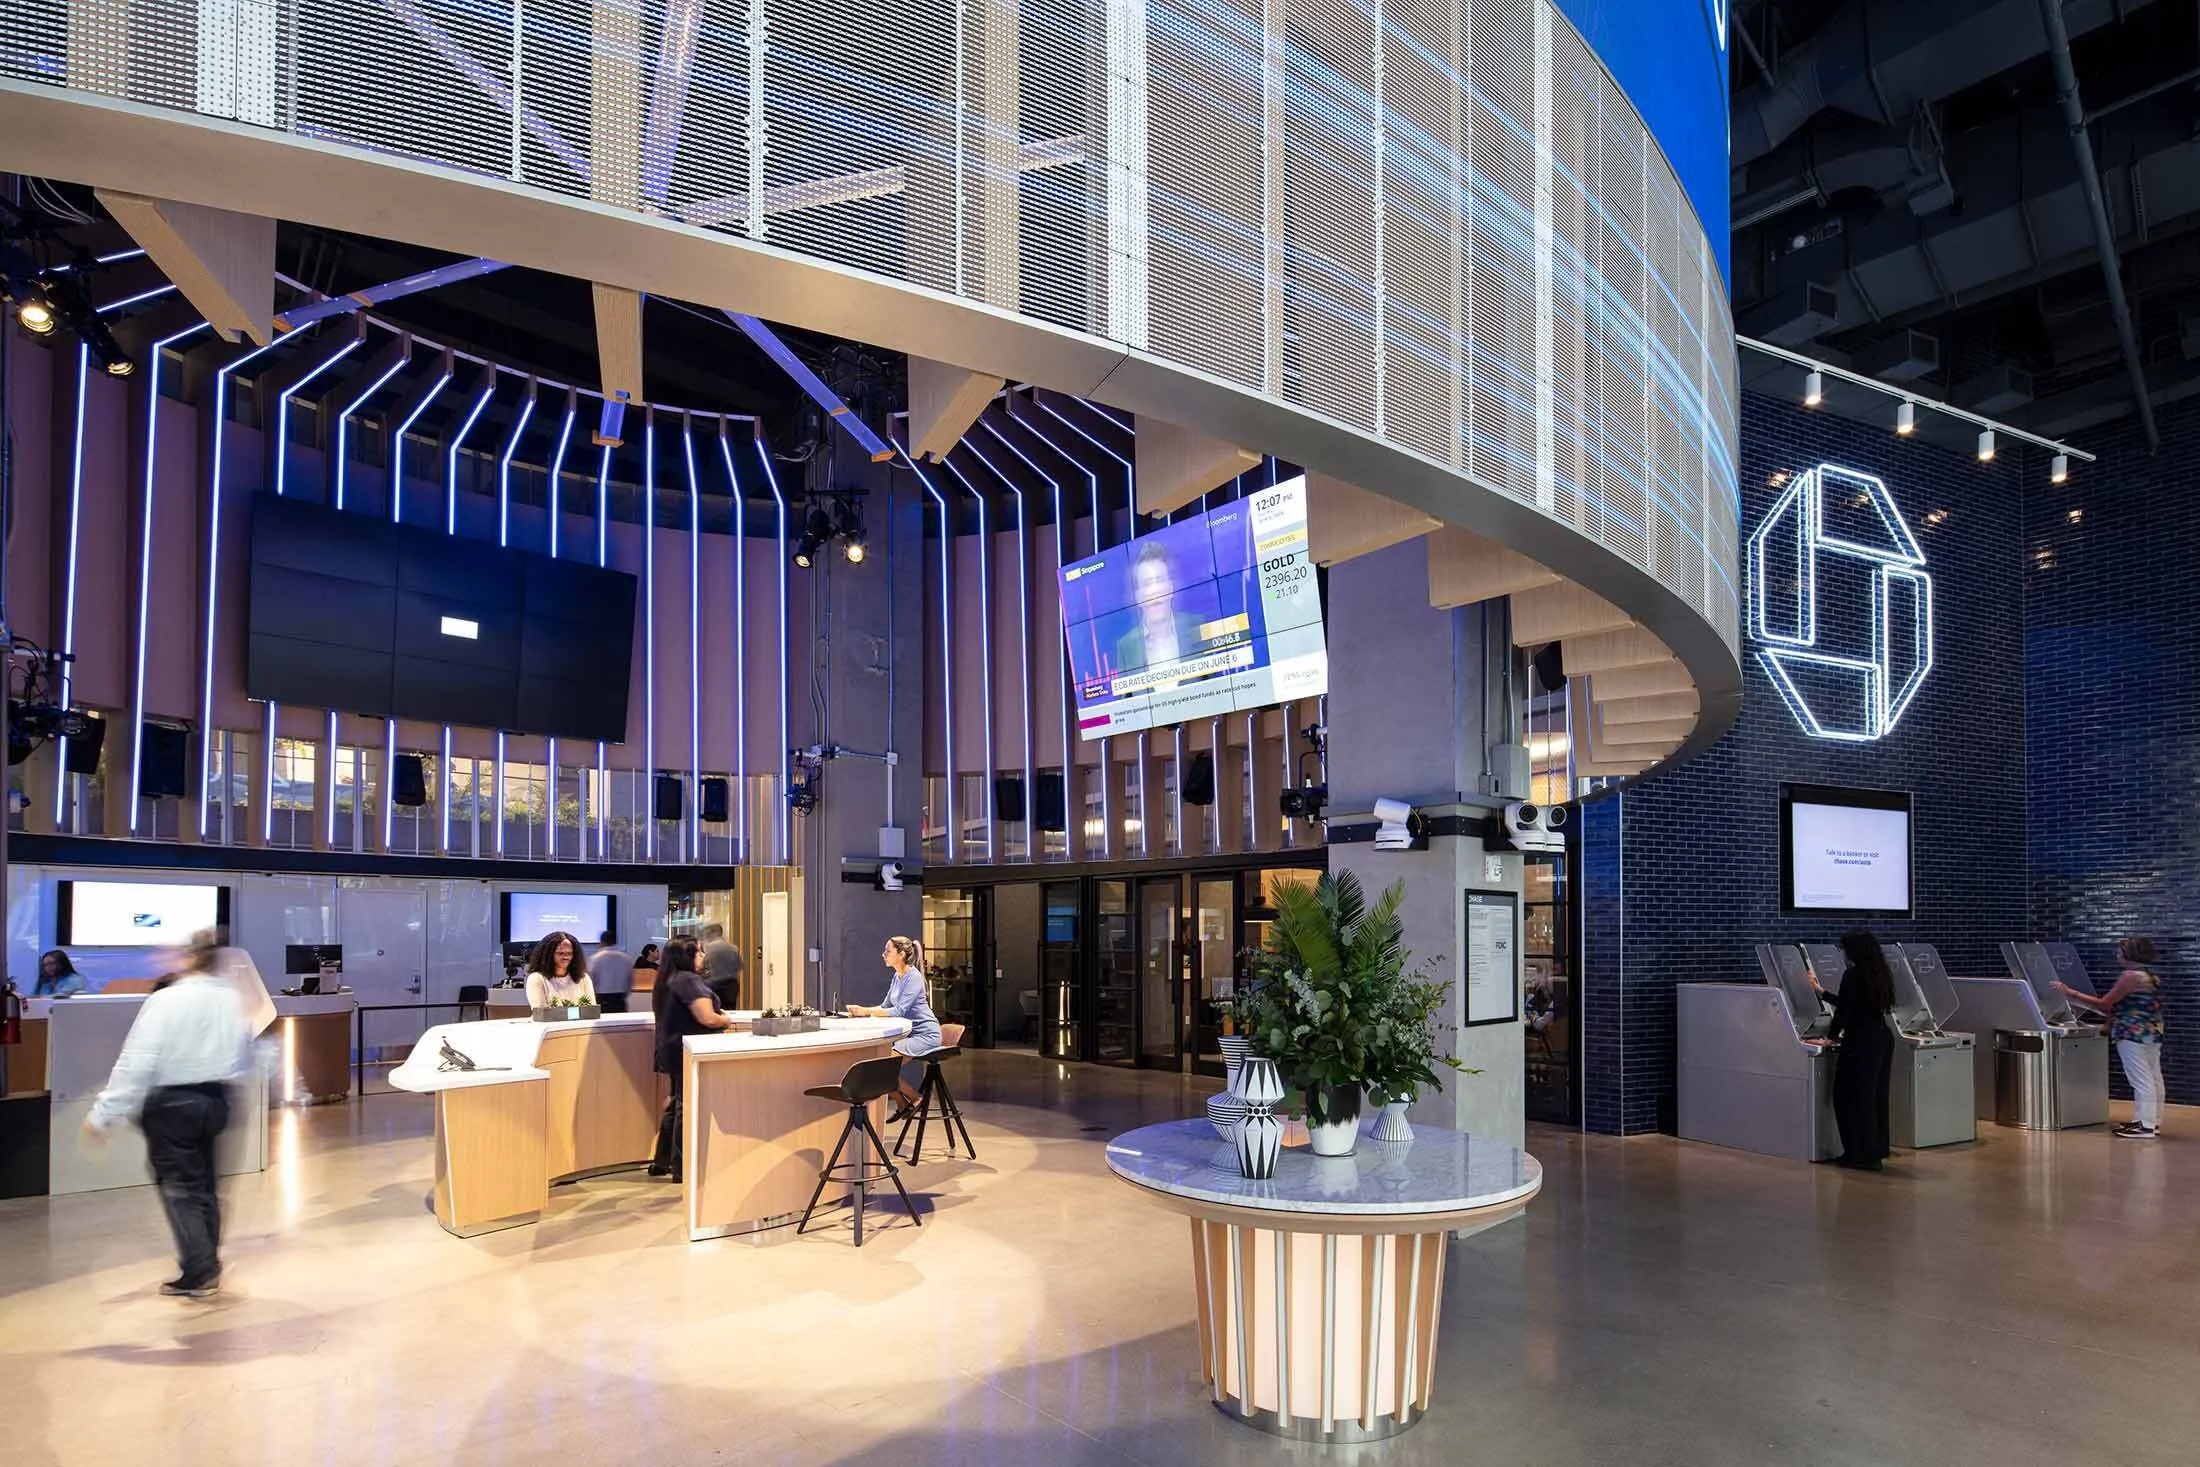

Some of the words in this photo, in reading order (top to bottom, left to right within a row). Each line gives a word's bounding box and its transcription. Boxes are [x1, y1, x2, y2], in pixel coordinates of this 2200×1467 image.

[1256, 494, 1281, 511] 12:07
[1206, 513, 1238, 528] Bloomberg
[1263, 554, 1295, 572] GOLD
[1265, 566, 1307, 589] 2396.20
[1276, 584, 1299, 599] 21.10
[1114, 680, 1128, 691] ECB
[1129, 676, 1147, 687] RATE
[1147, 666, 1180, 683] DECISION
[1181, 663, 1196, 675] DUE
[1198, 660, 1209, 671] ON
[1210, 654, 1230, 667] JUNE
[1232, 654, 1238, 662] 6
